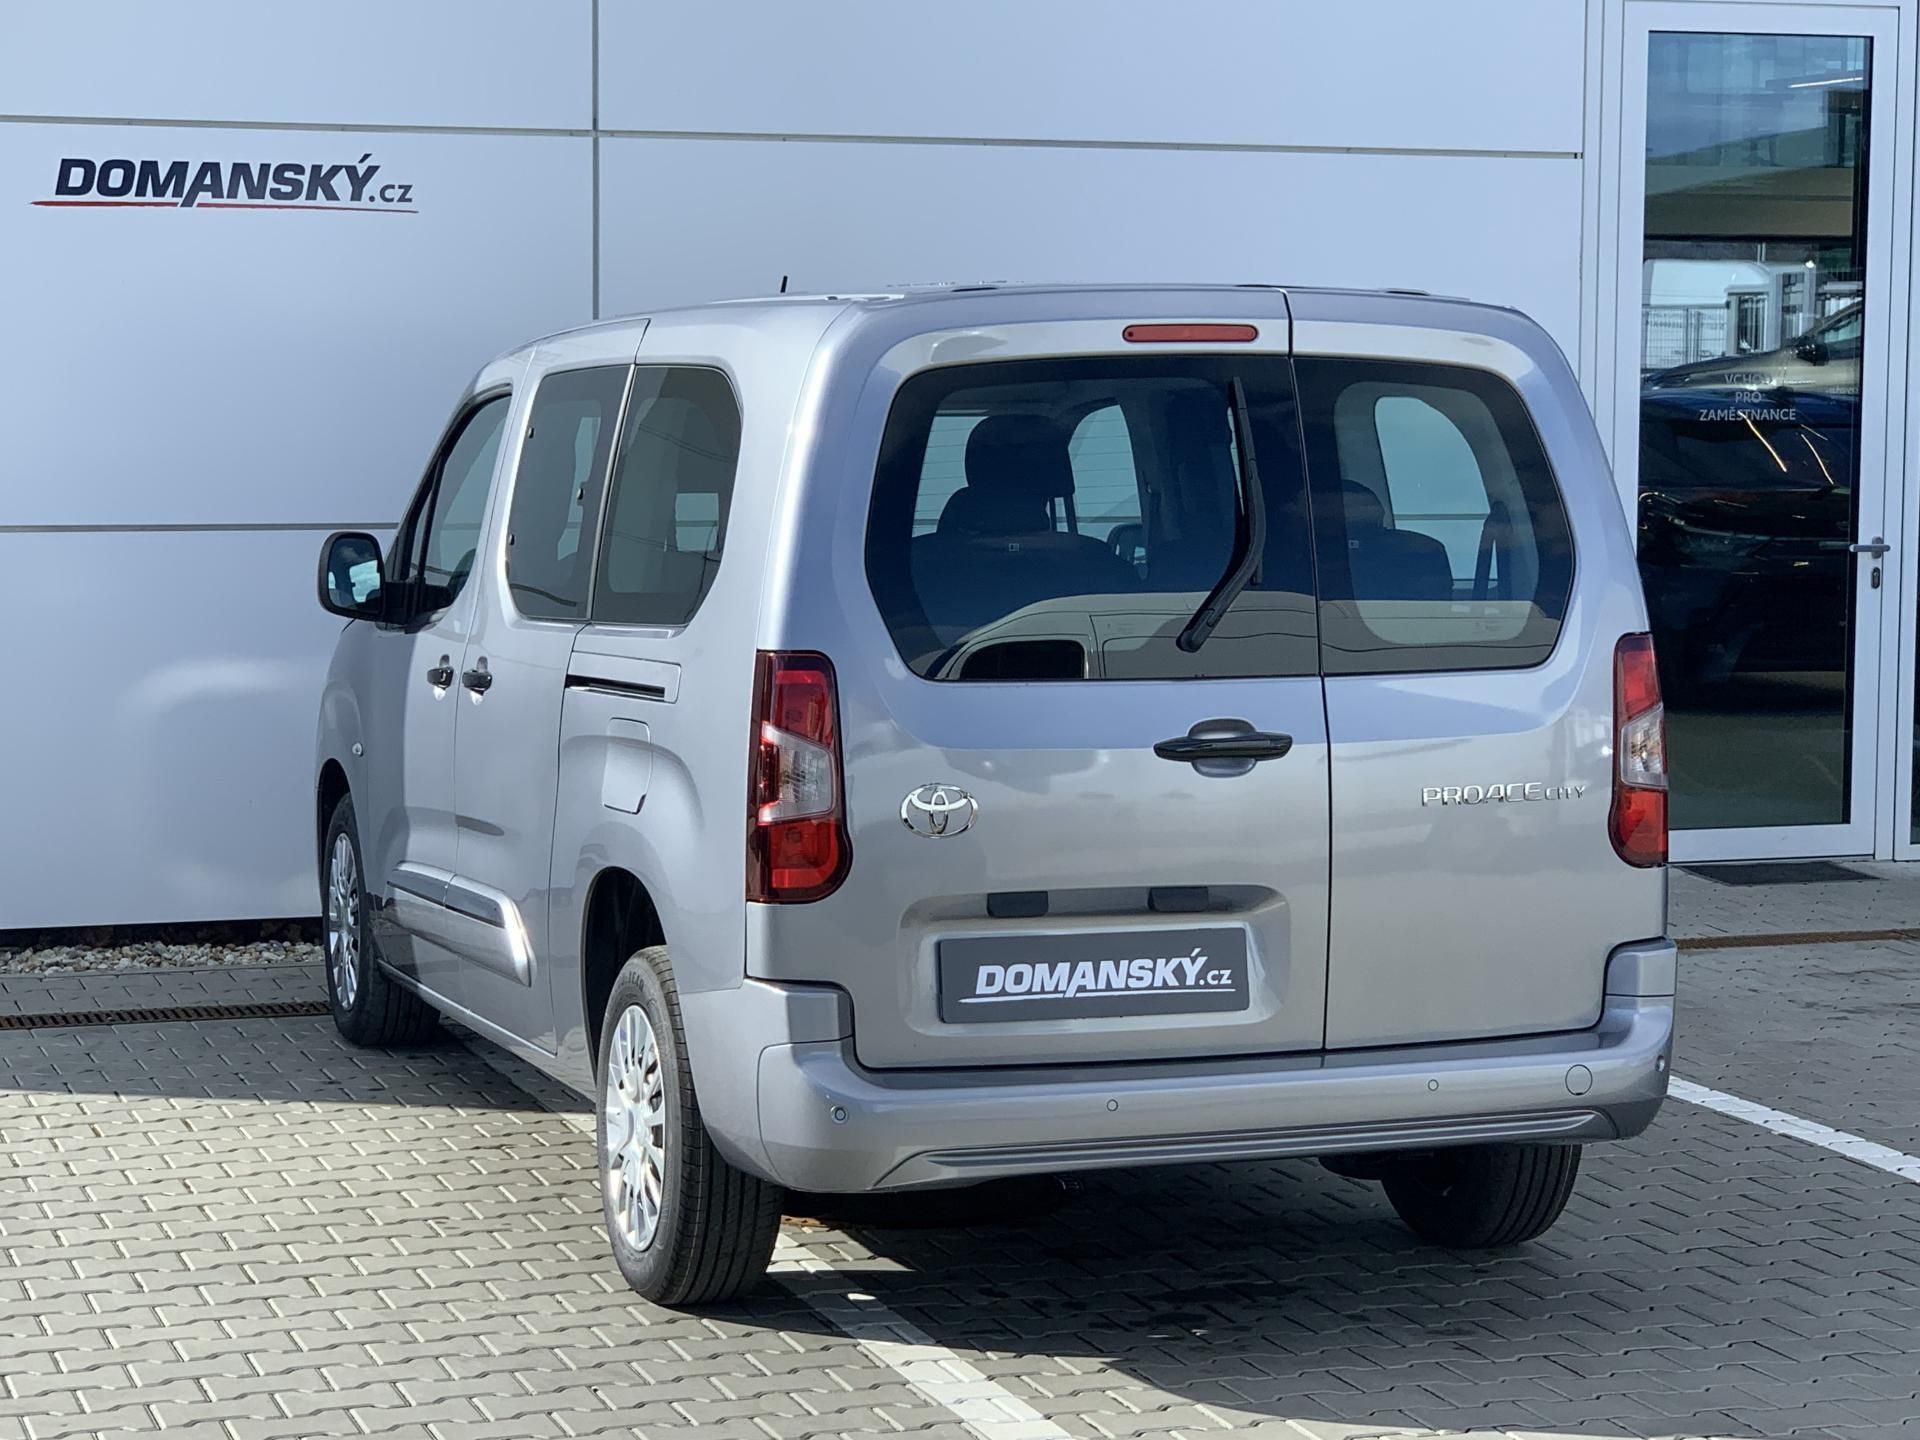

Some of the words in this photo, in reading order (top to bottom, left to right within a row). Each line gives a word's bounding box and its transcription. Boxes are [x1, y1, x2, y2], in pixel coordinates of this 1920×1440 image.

[1724, 373, 1772, 386] VCHO
[1735, 391, 1762, 404] PRO
[1700, 406, 1796, 421] ZAMĚSTNANCE
[1421, 782, 1542, 807] PROACE
[1545, 785, 1586, 801] CITY
